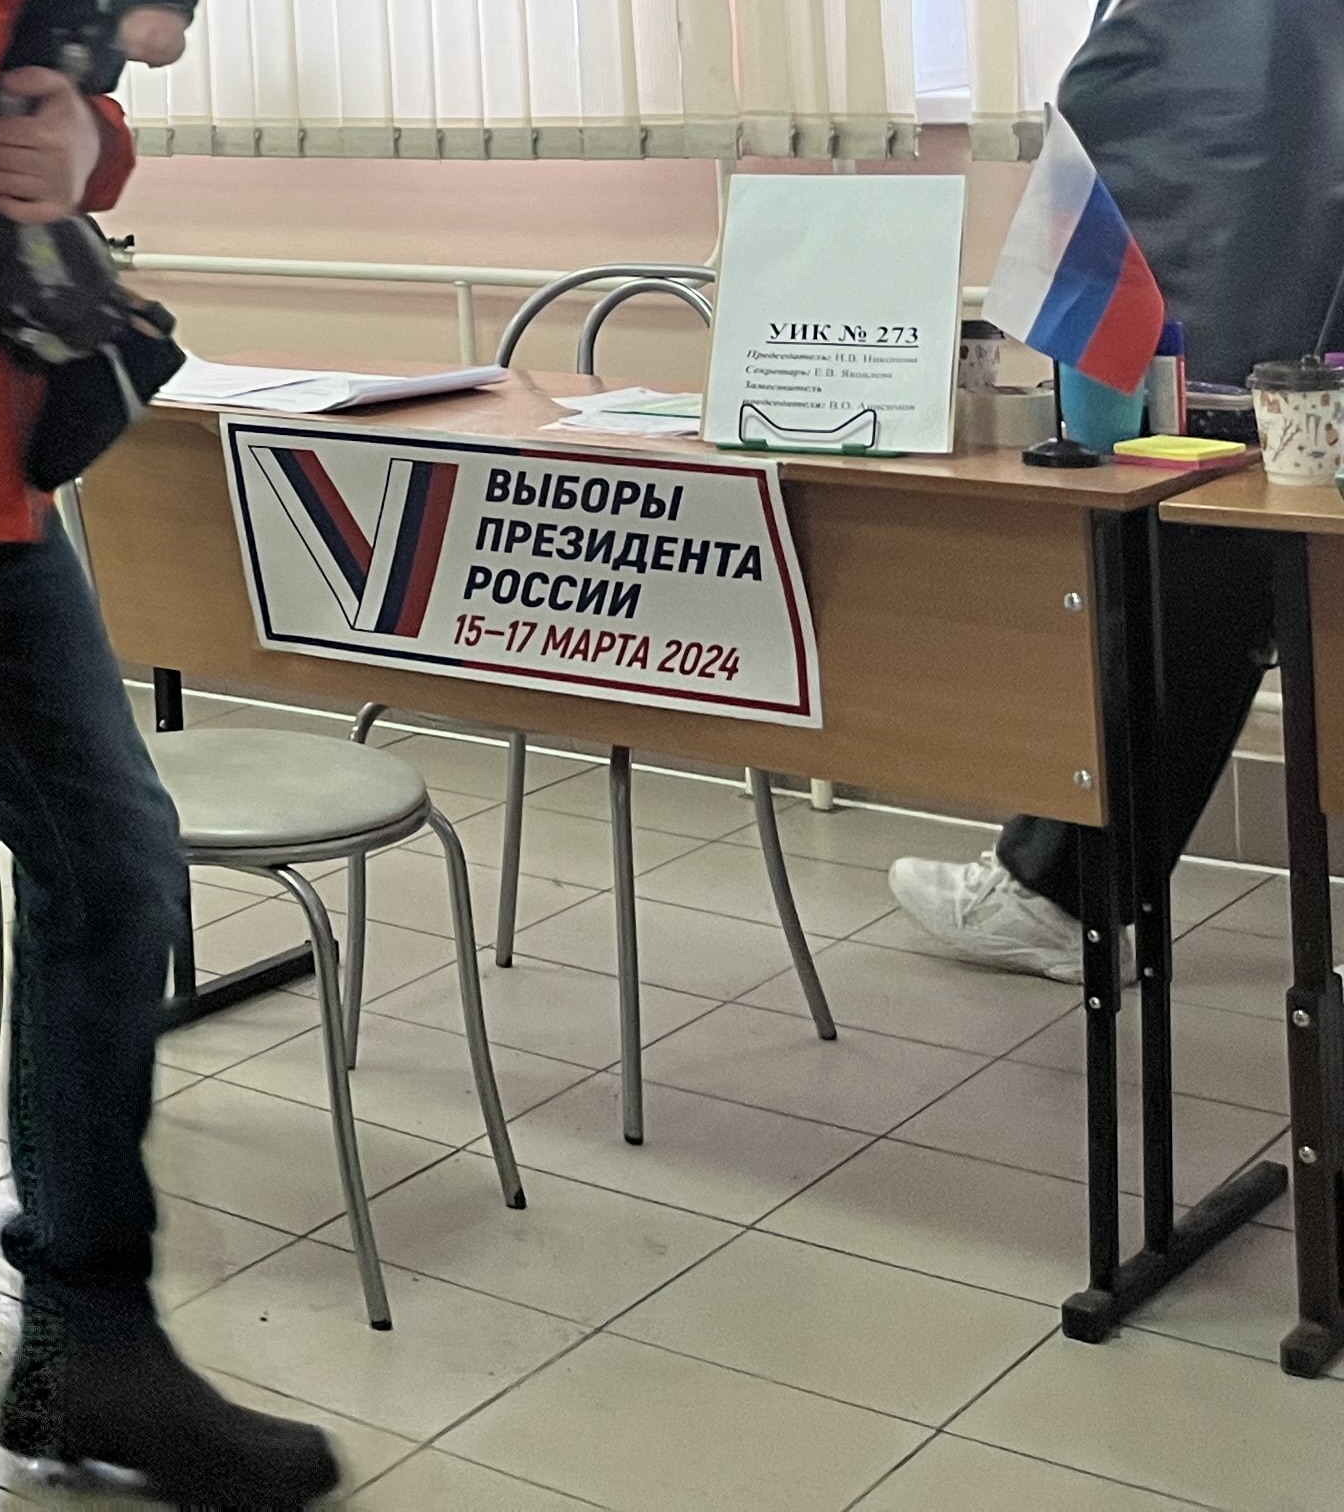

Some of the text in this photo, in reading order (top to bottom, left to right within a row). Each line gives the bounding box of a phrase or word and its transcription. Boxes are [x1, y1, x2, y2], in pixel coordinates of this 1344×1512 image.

[768, 322, 919, 344] УИК № 273
[485, 467, 684, 521] ВЫБОРЫ
[475, 516, 763, 581] ПРЕЗИДЕНТА
[463, 565, 642, 619] РОССИИ
[540, 624, 650, 670] МАРТА
[656, 639, 739, 681] 2024
